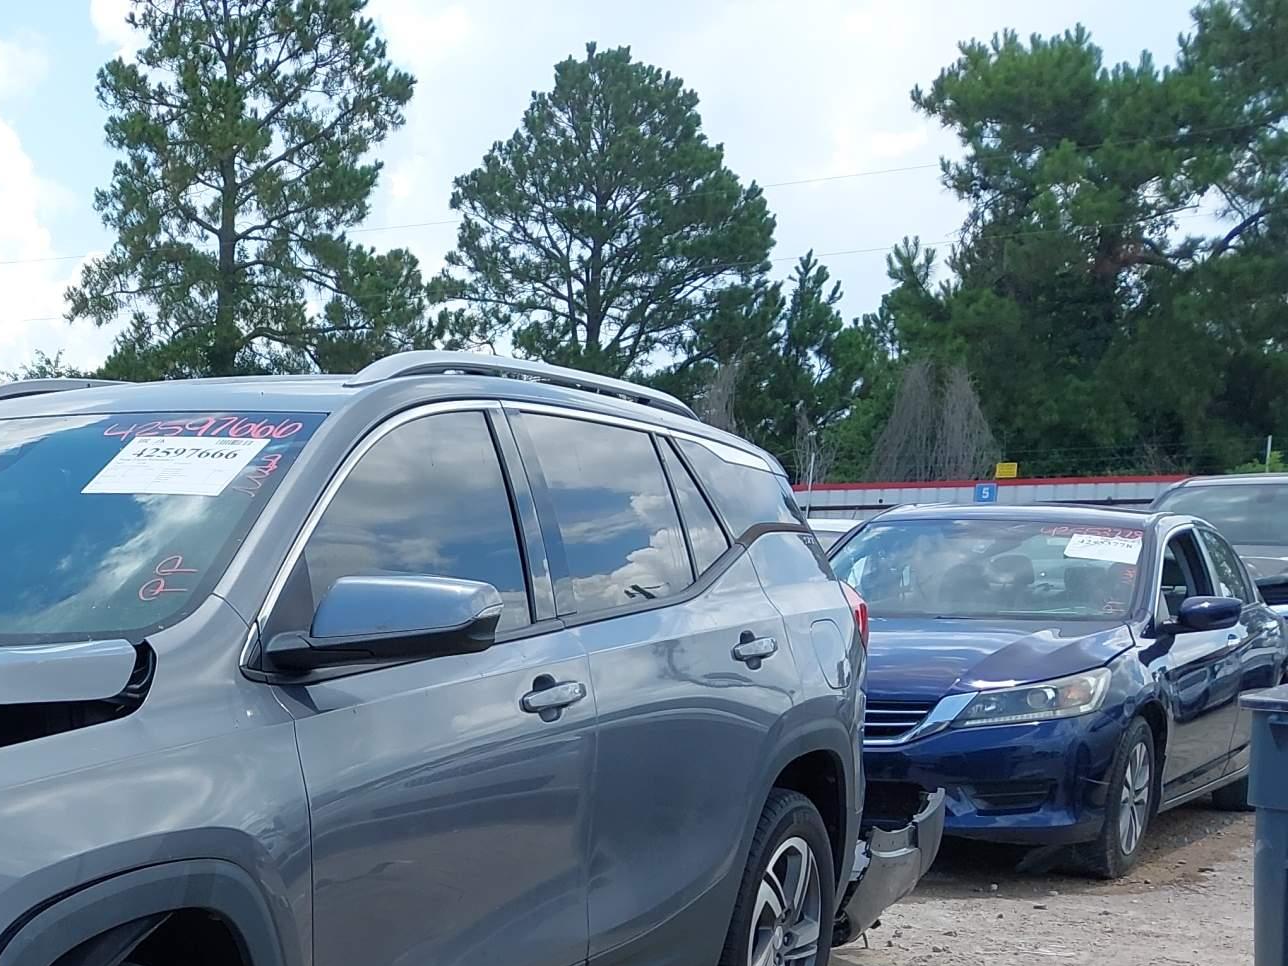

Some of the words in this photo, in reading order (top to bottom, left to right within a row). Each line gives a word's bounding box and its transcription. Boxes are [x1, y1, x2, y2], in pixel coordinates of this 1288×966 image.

[103, 416, 303, 442] 42597666
[132, 447, 241, 460] 42597666
[981, 487, 990, 499] 5
